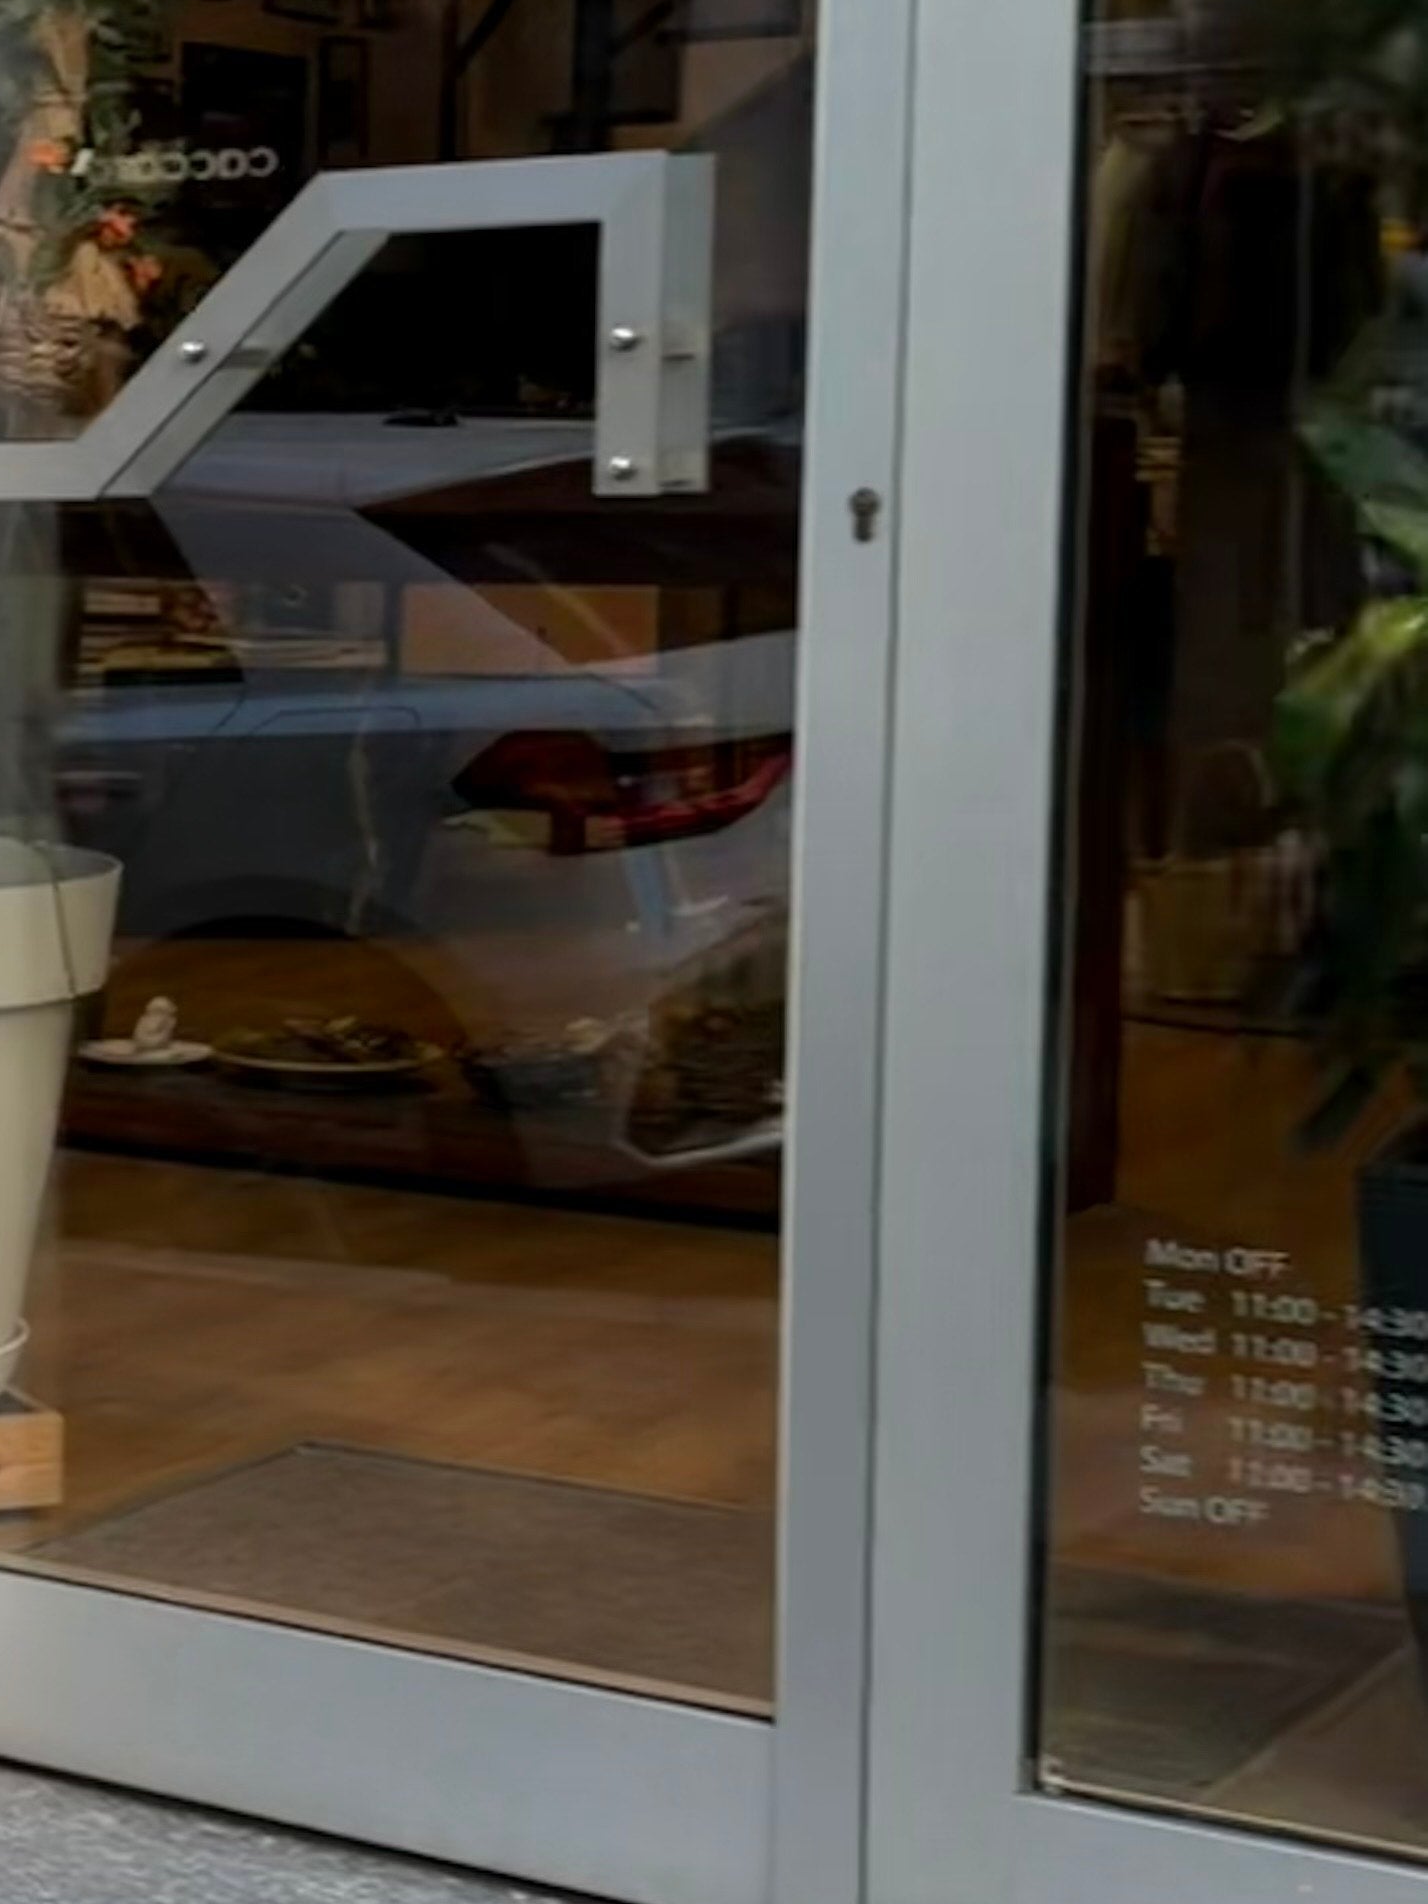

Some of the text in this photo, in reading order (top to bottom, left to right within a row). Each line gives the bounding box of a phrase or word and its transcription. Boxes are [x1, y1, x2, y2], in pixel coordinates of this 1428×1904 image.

[1144, 1238, 1289, 1278] Mon OFF
[1205, 1495, 1270, 1525] OFF
